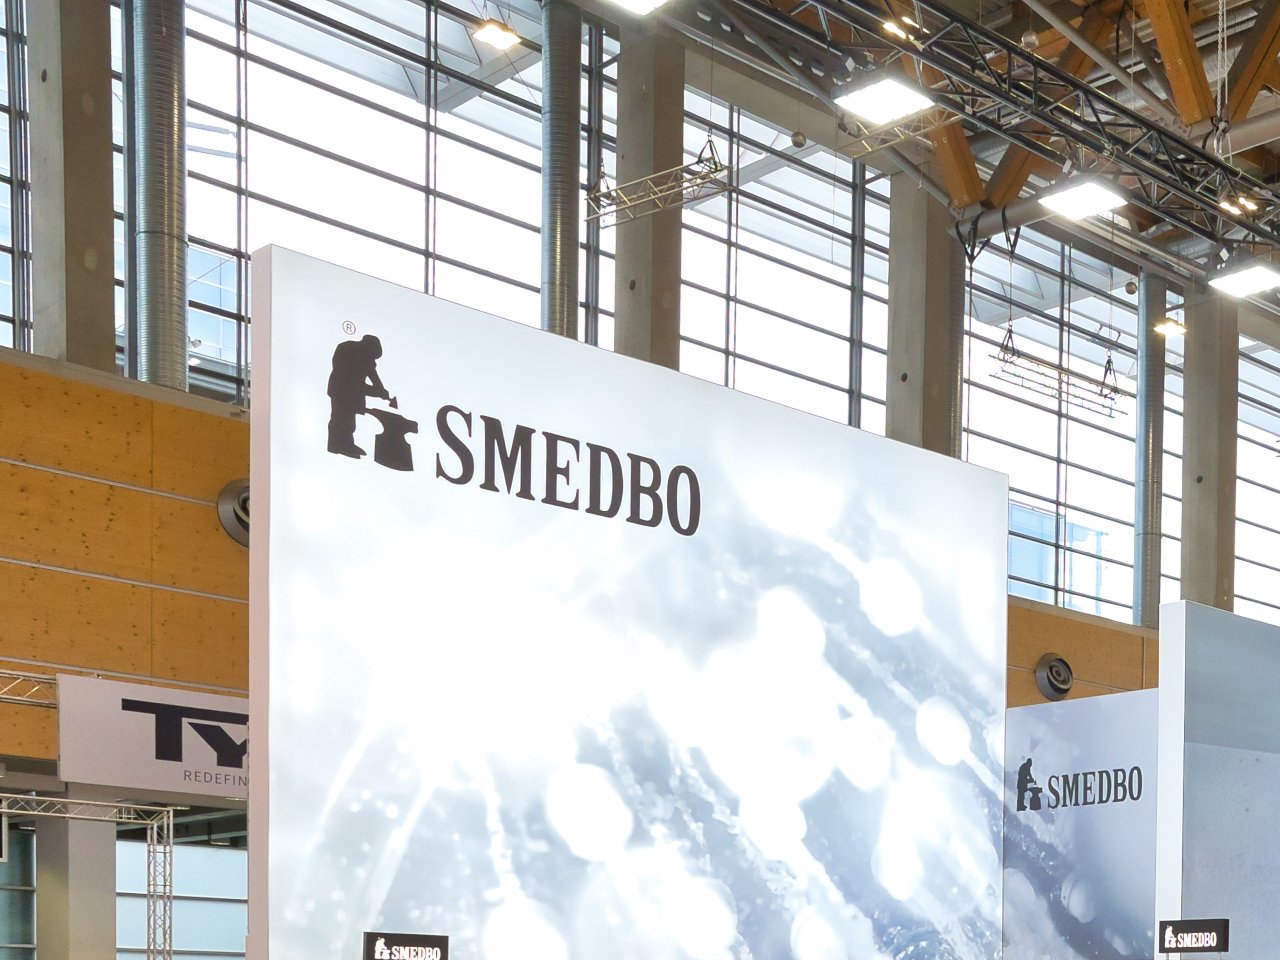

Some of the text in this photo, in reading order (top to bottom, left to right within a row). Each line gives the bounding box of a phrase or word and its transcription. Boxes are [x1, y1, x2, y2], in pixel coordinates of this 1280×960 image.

[436, 404, 701, 536] SMEDBO
[1047, 766, 1143, 809] SMEDBO
[1177, 932, 1217, 948] SMEDBO
